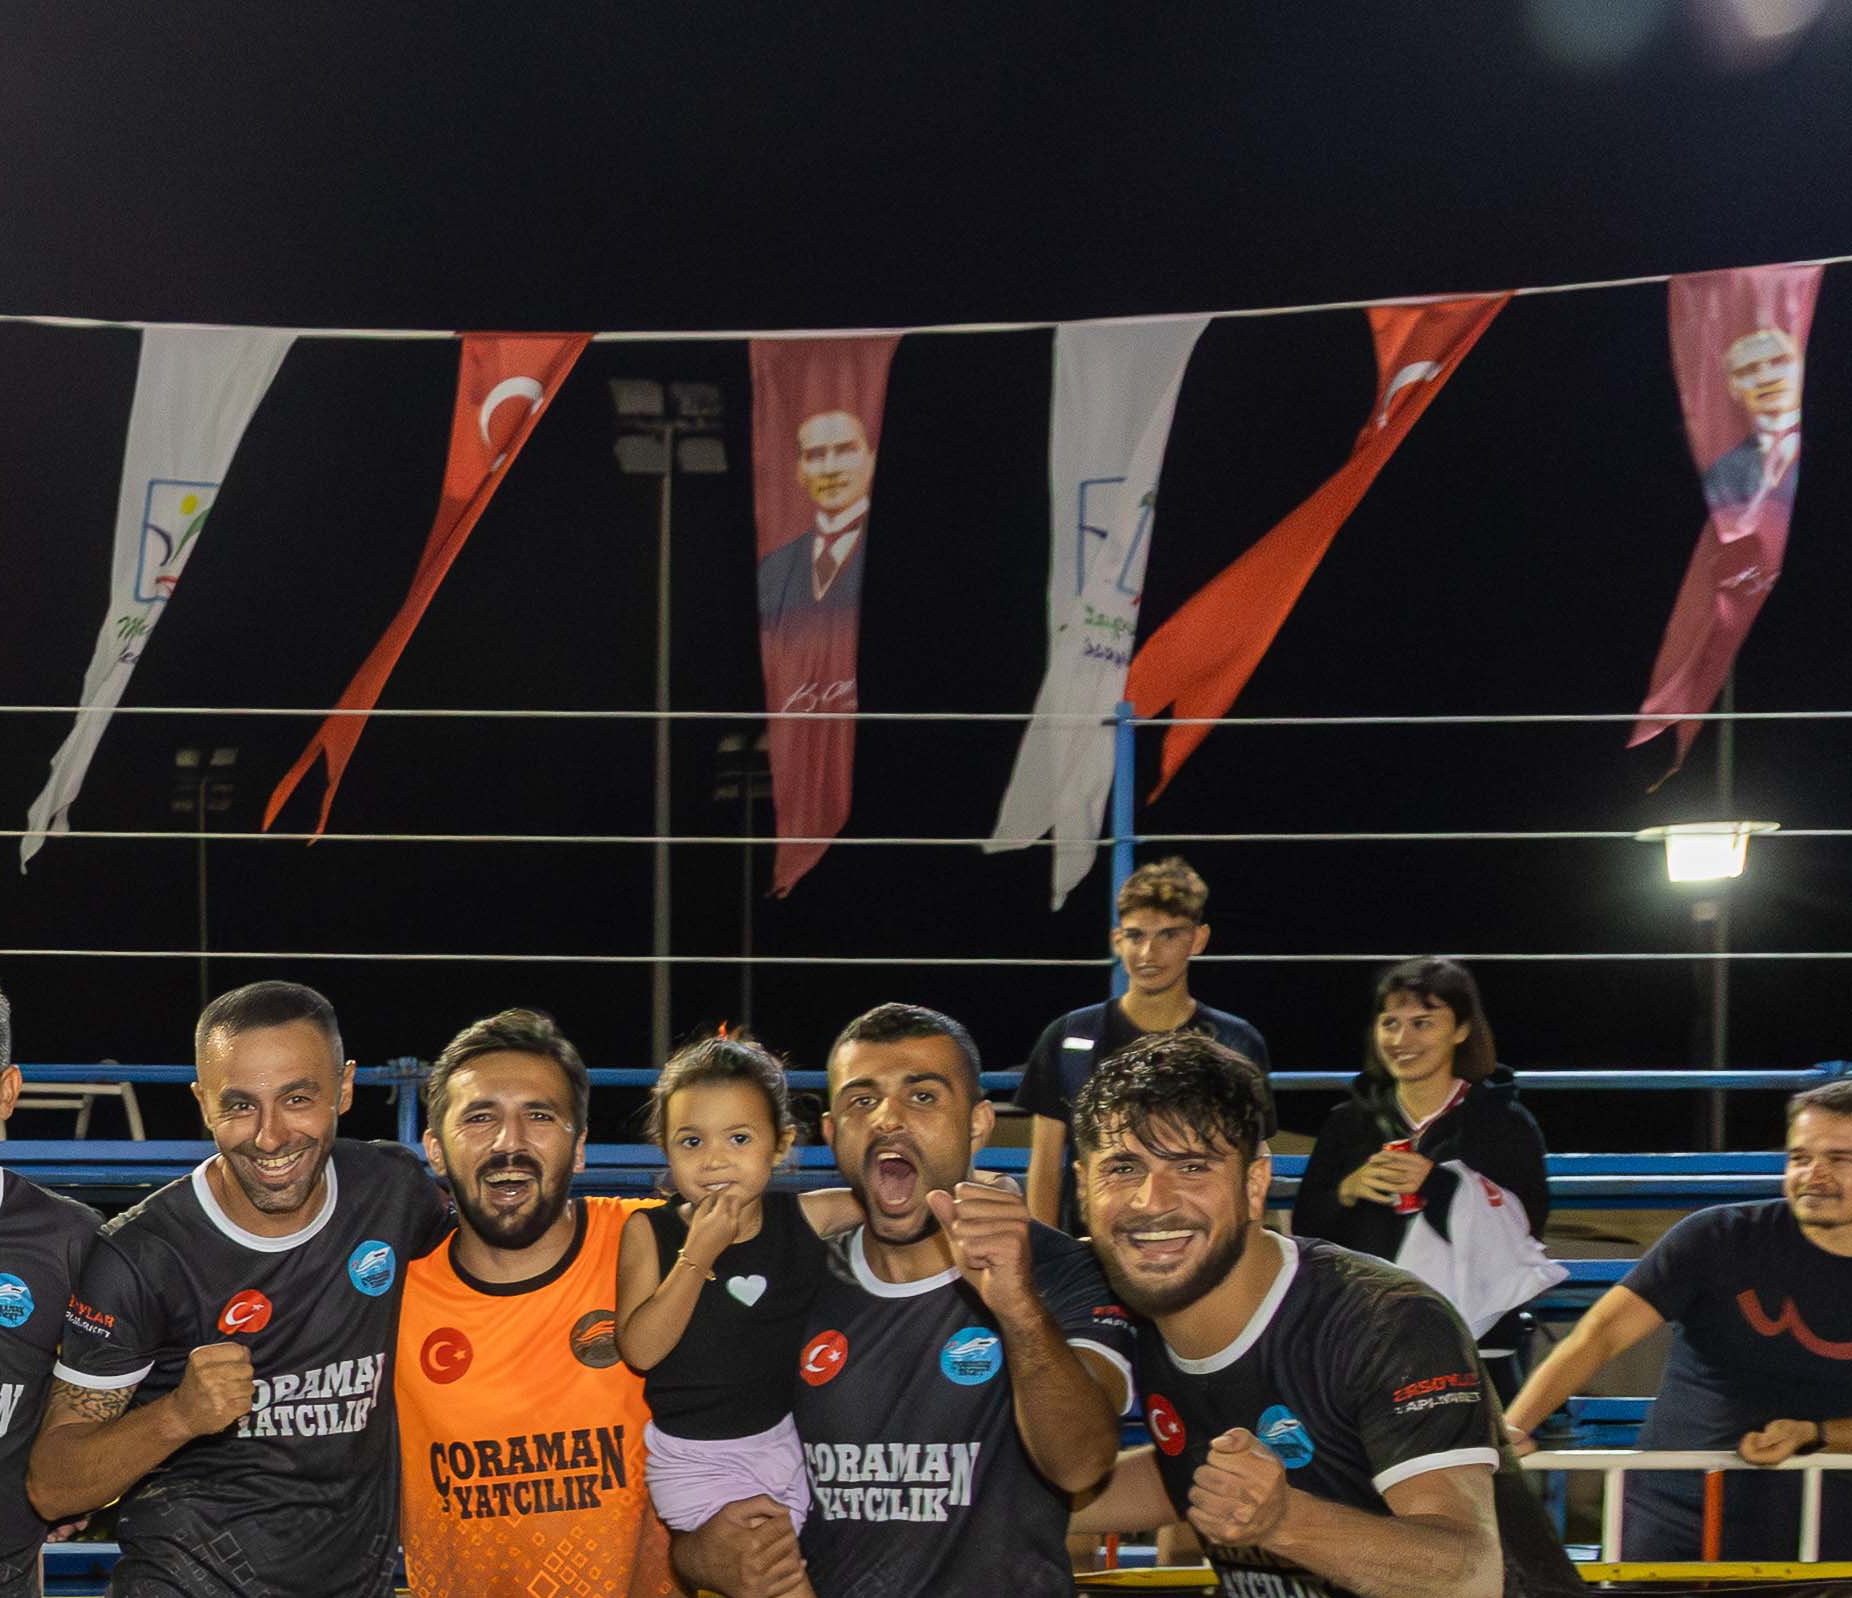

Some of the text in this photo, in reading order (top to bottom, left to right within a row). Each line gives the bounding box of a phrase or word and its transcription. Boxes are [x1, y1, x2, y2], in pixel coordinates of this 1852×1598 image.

[251, 1352, 386, 1412] ORAMA
[430, 1425, 627, 1513] ÇORAMAN
[453, 1473, 602, 1520] YATCILIK
[816, 1487, 949, 1522] YATCILIK
